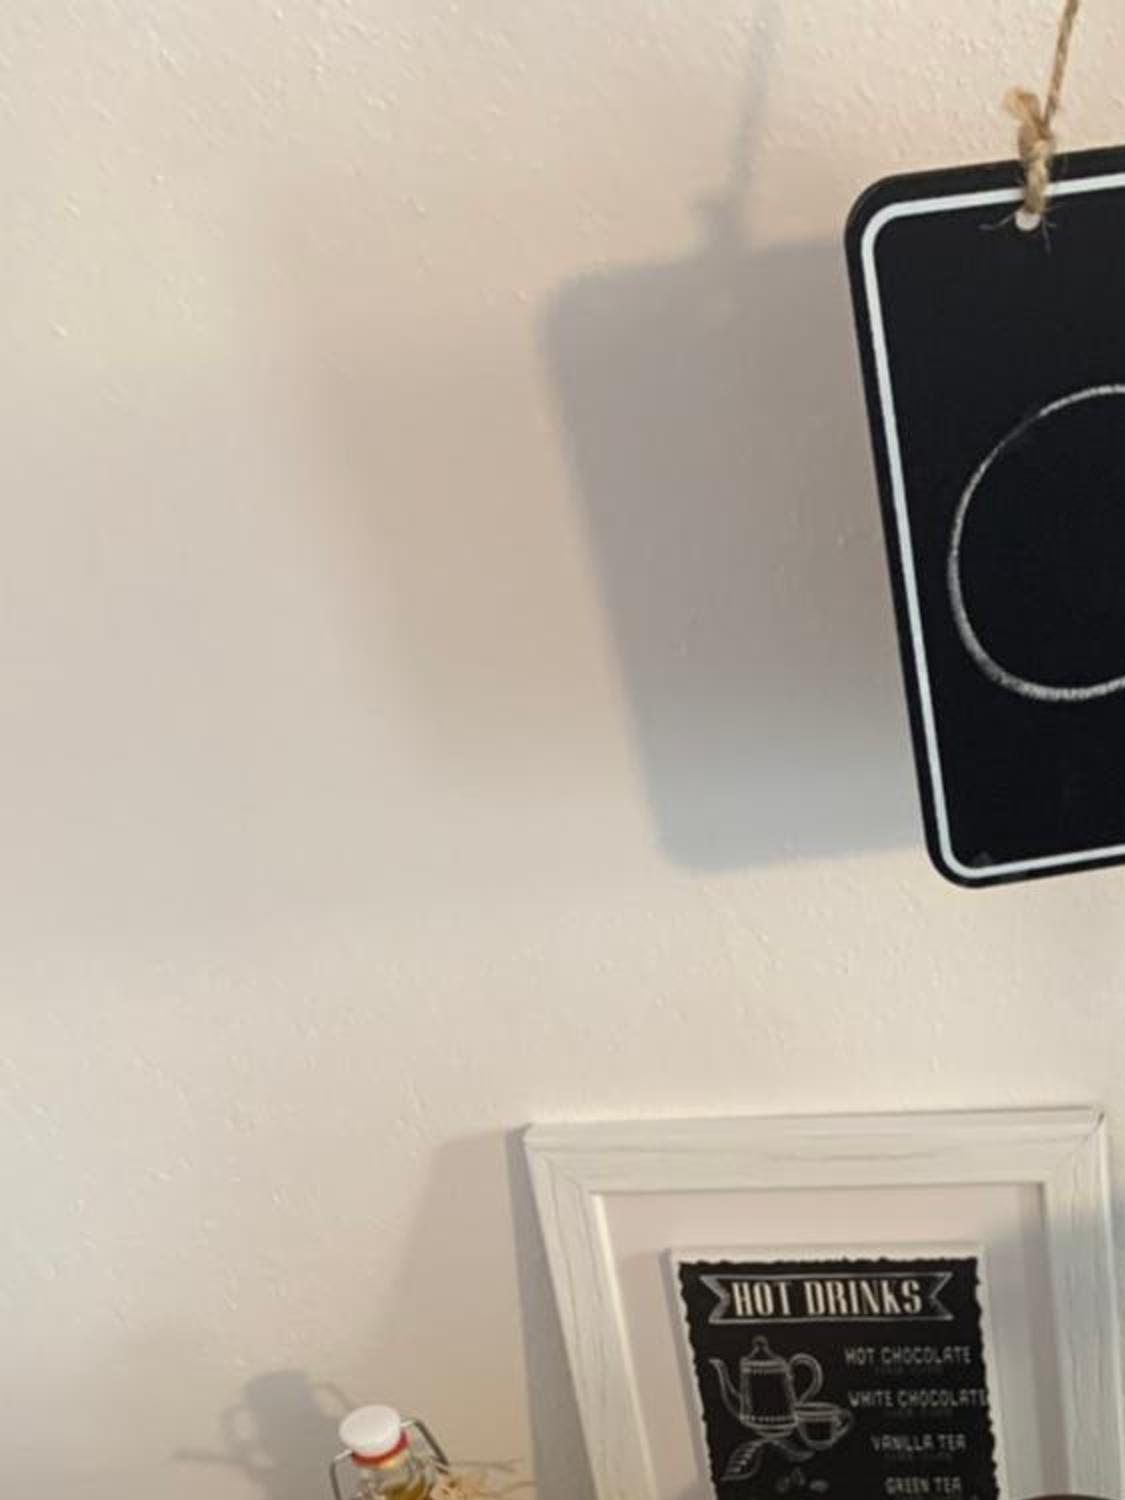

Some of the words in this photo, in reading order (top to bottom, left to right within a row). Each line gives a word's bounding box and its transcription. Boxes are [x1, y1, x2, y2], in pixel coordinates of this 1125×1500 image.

[731, 1279, 792, 1317] HOT
[804, 1278, 923, 1315] DRINKS
[844, 1347, 875, 1366] HOT
[881, 1346, 972, 1365] CHOCOLATE
[849, 1389, 894, 1408] WHITE
[896, 1389, 988, 1408] CHOCOLATE
[871, 1434, 935, 1452] VANILLA
[937, 1433, 966, 1451] TEA
[884, 1476, 930, 1495] GREEN
[933, 1475, 961, 1494] TEA
